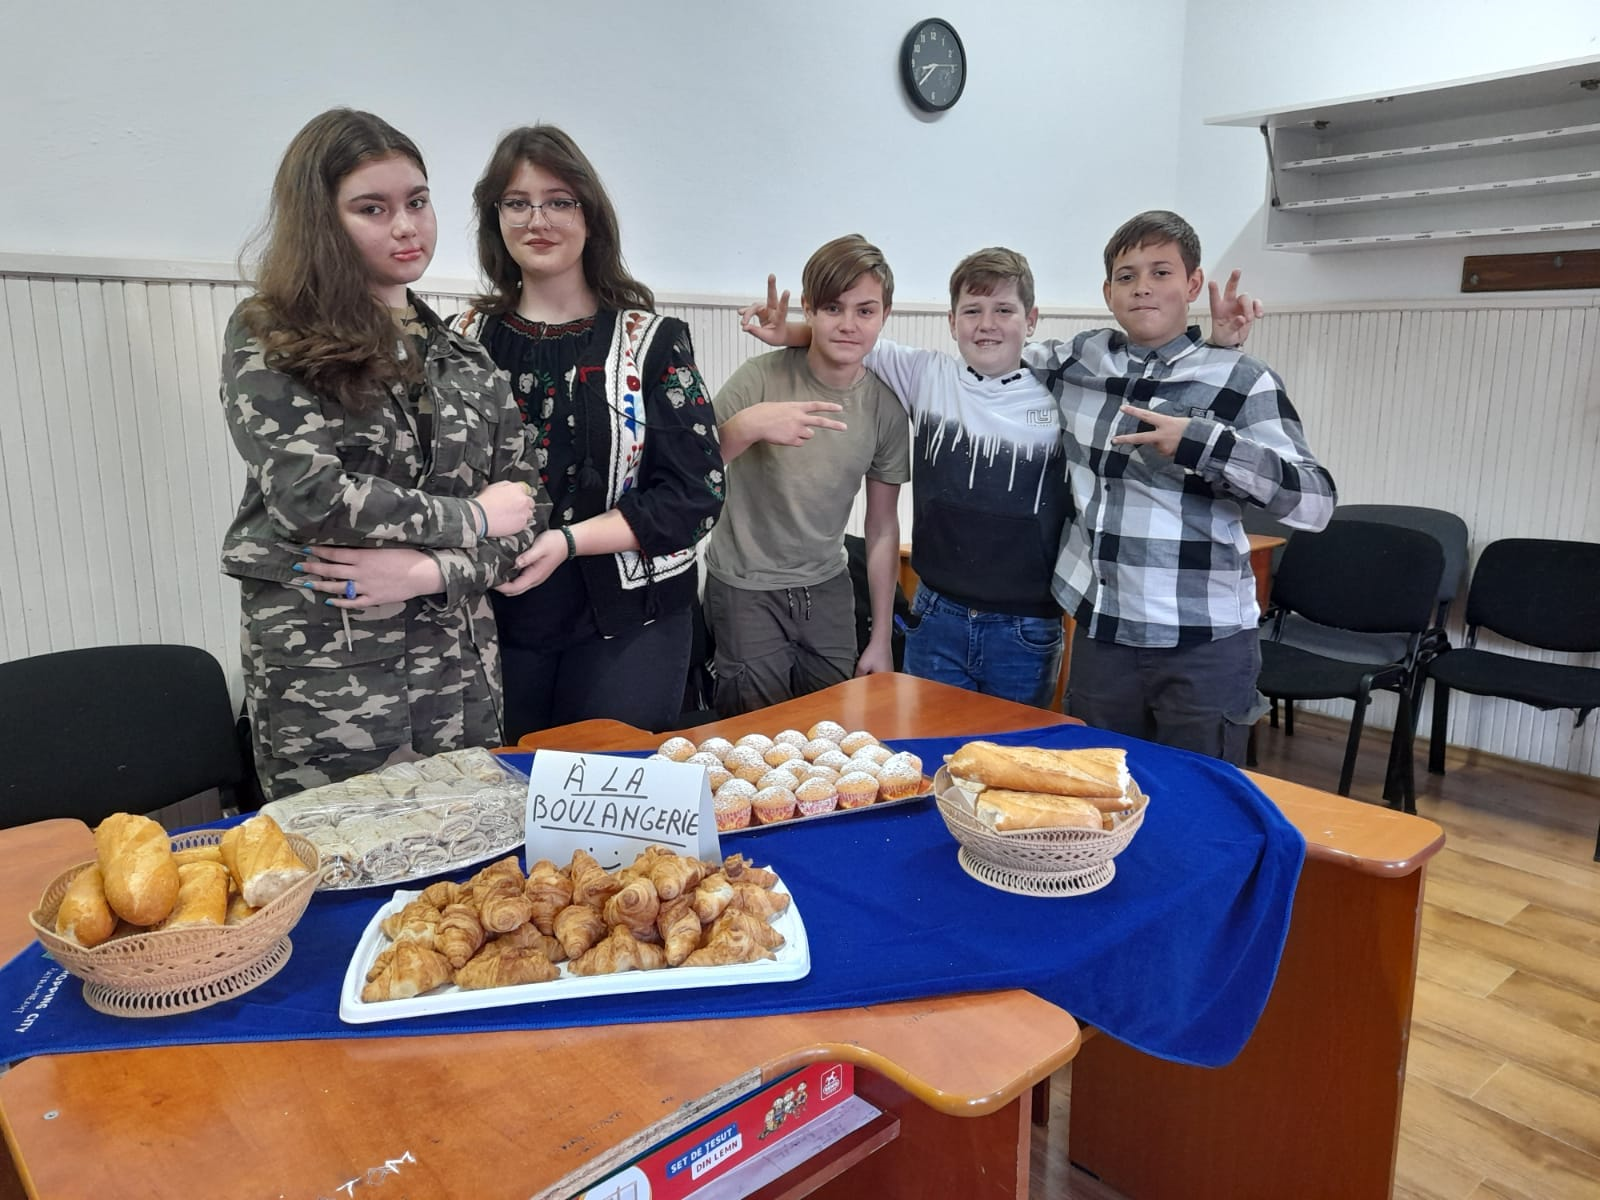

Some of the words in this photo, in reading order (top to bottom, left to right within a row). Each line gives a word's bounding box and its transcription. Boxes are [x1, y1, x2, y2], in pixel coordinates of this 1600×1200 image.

[563, 757, 588, 792] À
[600, 766, 645, 794] LA
[532, 794, 700, 836] BOULANGERIE
[35, 968, 71, 1010] HOPPING
[14, 1013, 40, 1033] CITY
[670, 1156, 688, 1174] SET
[690, 1147, 703, 1161] DE
[696, 1157, 712, 1173] DIN
[714, 1140, 738, 1161] LEMN
